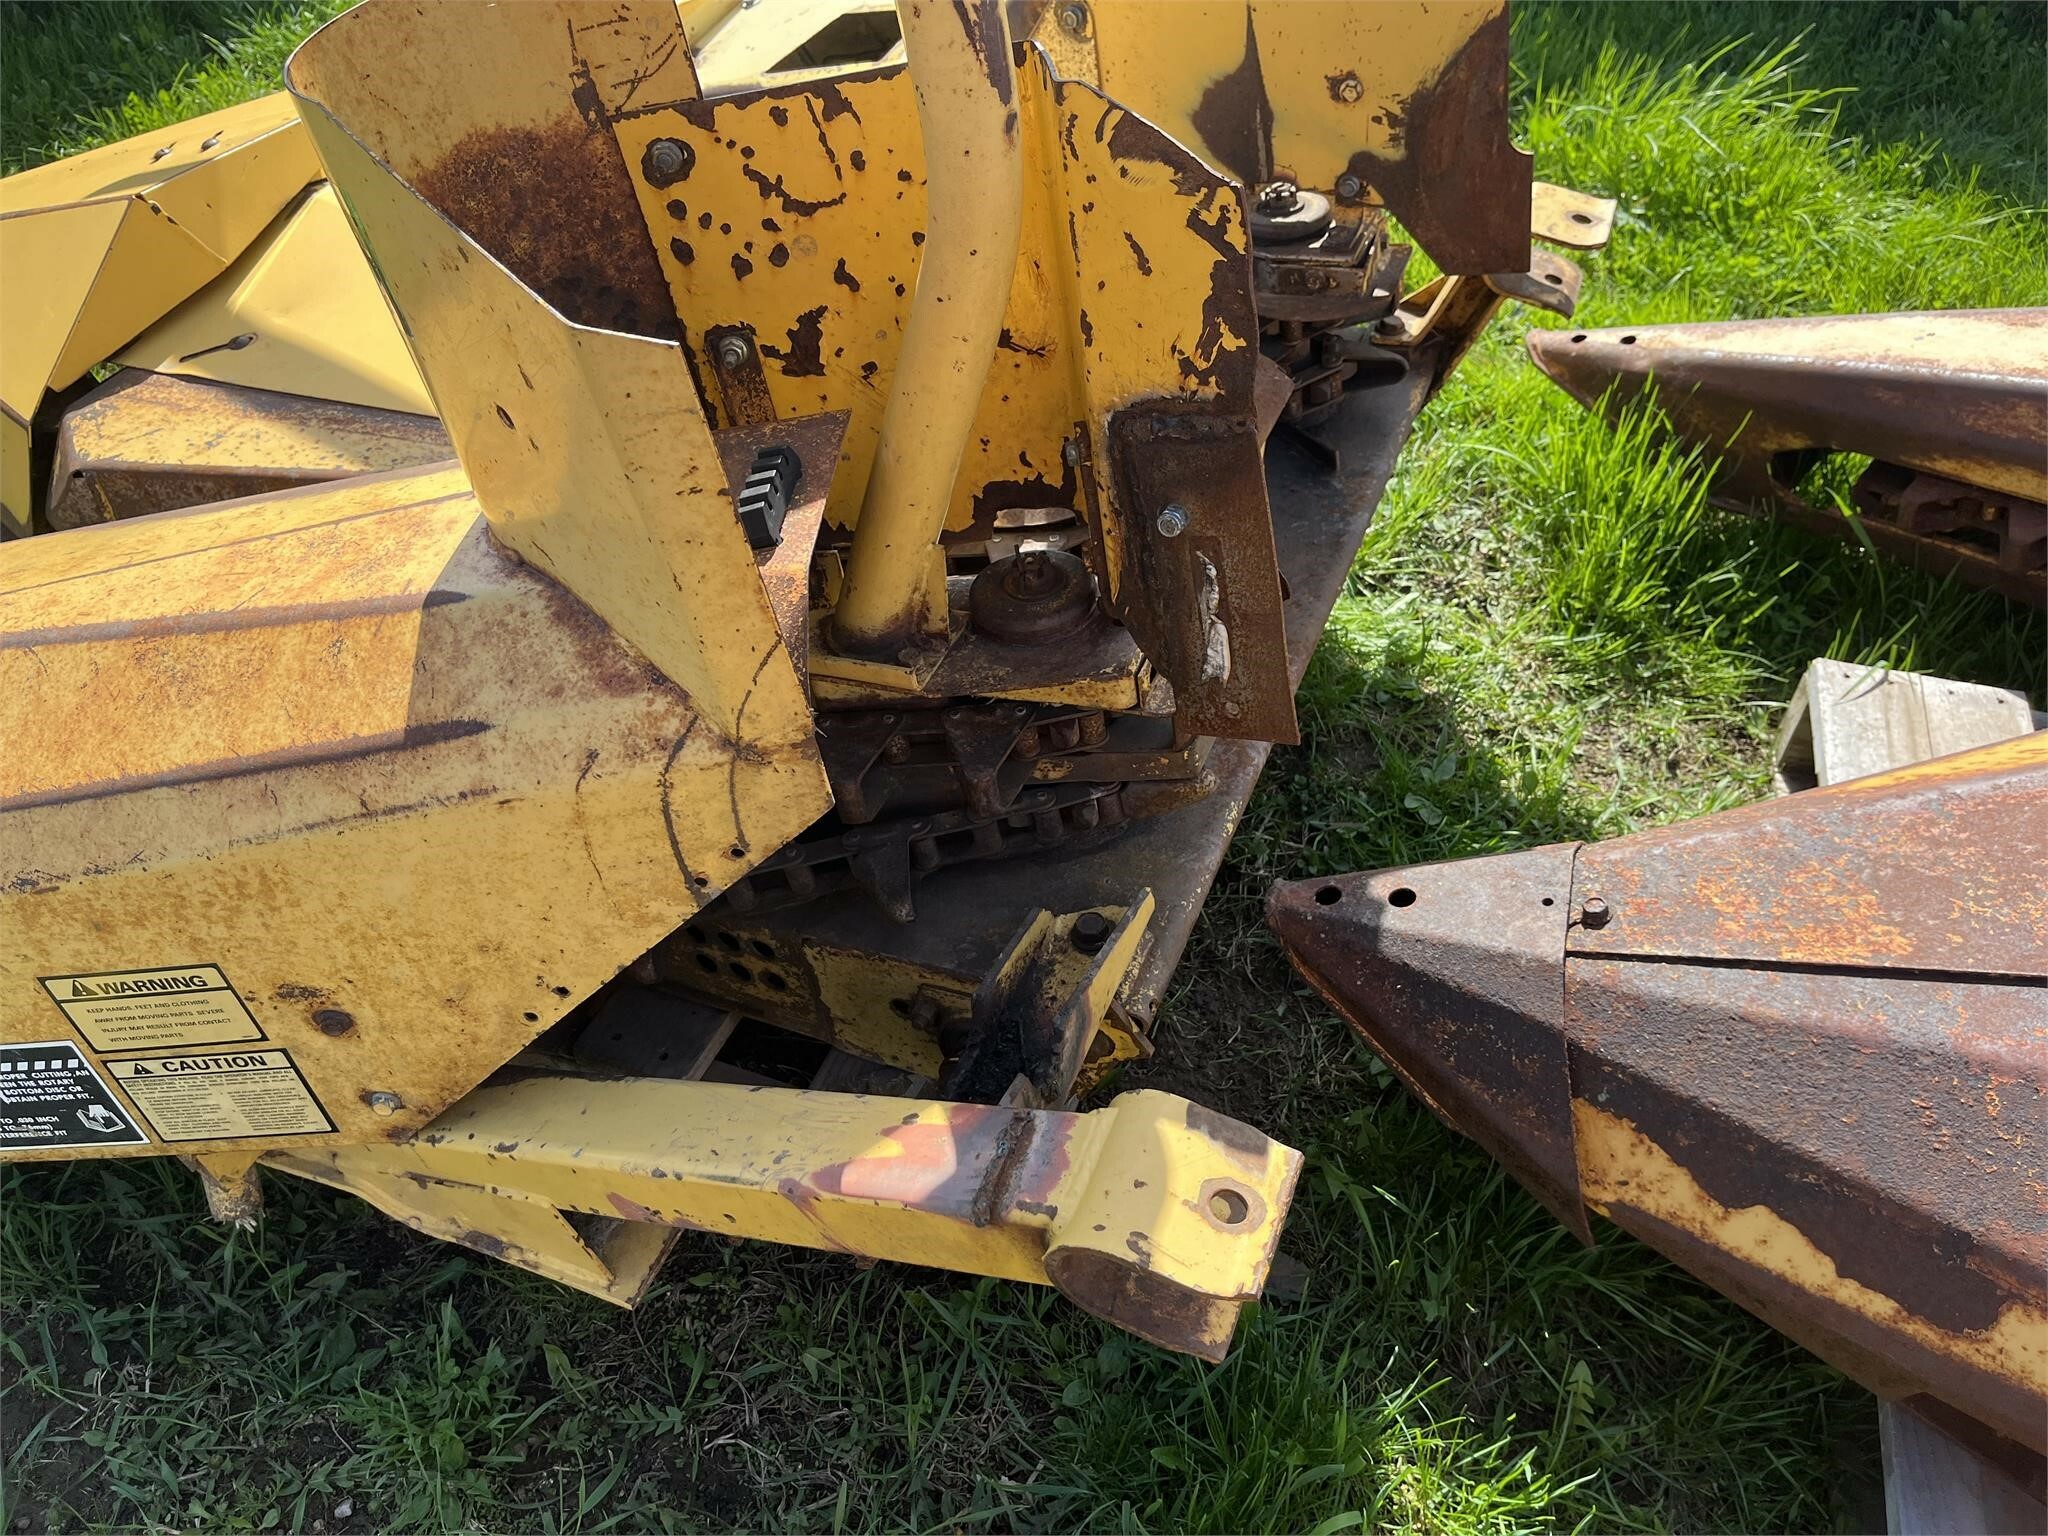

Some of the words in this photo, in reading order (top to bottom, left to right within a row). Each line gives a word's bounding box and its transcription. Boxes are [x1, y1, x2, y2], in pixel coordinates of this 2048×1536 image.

[96, 975, 209, 995] WARNING
[171, 999, 210, 1007] CLOTHING
[195, 1008, 225, 1016] SEVERE
[161, 1055, 268, 1073] CAUTION
[18, 1079, 37, 1087] THE
[37, 1078, 75, 1087] ROTARY
[3, 1088, 44, 1097] BOTTOM
[45, 1086, 68, 1094] DISC
[68, 1084, 84, 1093] OR
[4, 1094, 38, 1103] OBTAIN
[39, 1093, 75, 1101] PROPER
[75, 1092, 95, 1100] FIT.
[35, 1115, 60, 1123] INCH
